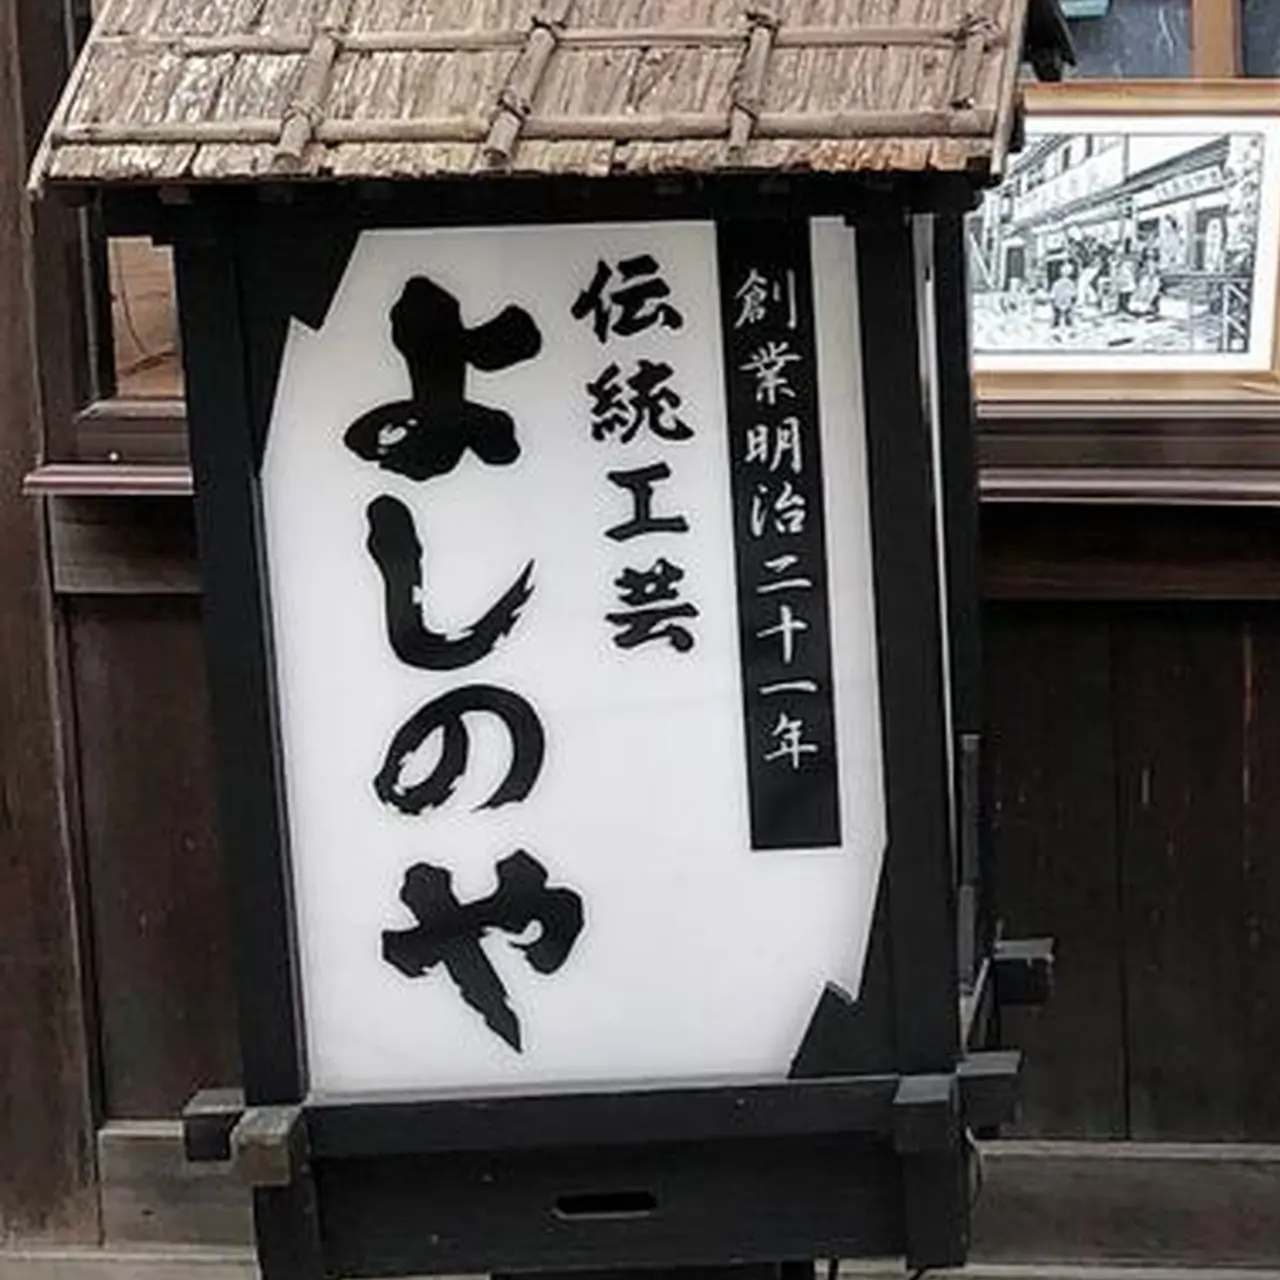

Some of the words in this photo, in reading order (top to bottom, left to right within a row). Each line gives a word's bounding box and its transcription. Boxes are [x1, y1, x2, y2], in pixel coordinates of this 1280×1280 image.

[344, 274, 585, 1053] よしのや
[571, 254, 700, 654] 伝統工芸
[732, 267, 818, 772] 創業明治二十一年
